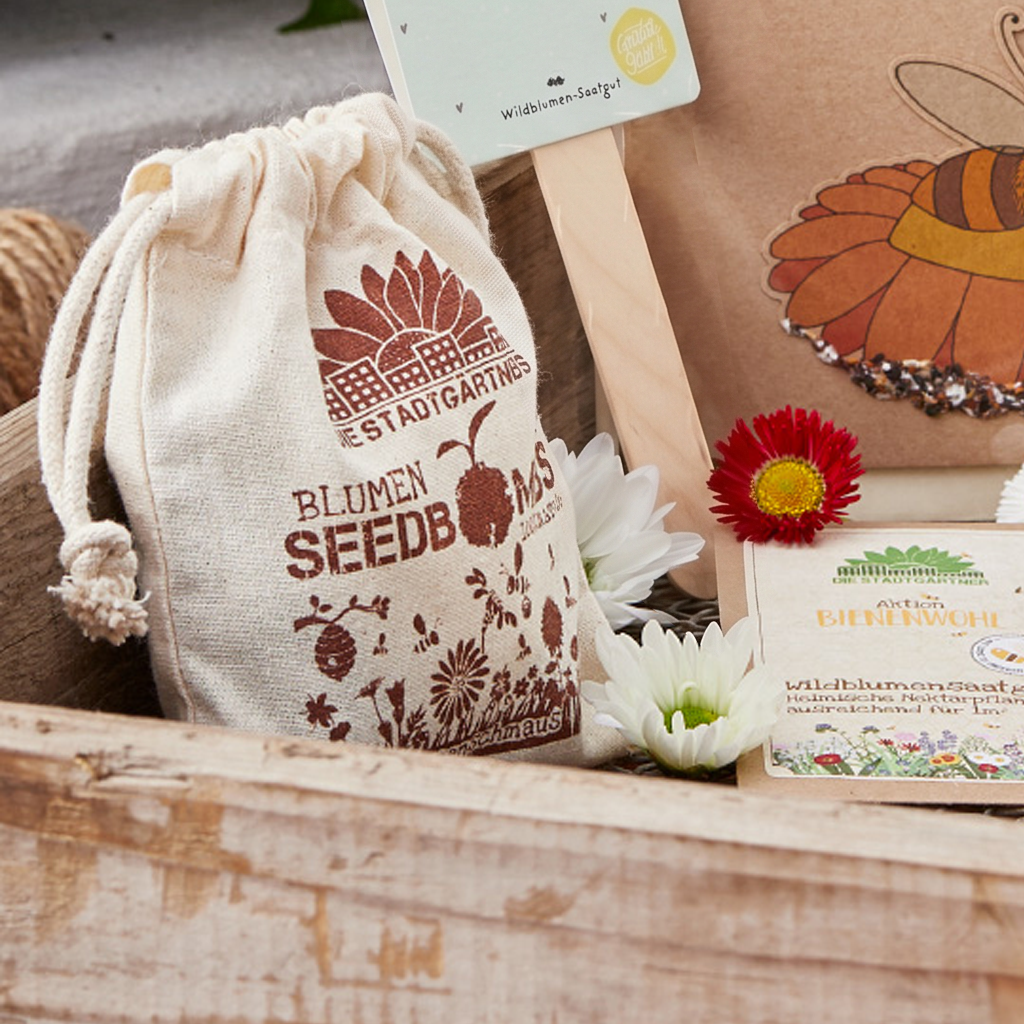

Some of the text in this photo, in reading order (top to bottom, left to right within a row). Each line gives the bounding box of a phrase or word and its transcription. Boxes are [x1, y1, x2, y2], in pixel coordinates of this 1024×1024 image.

[500, 77, 622, 120] Wildblumen-Saatgut
[292, 460, 428, 522] BLUMEN
[876, 598, 945, 609] Aktion
